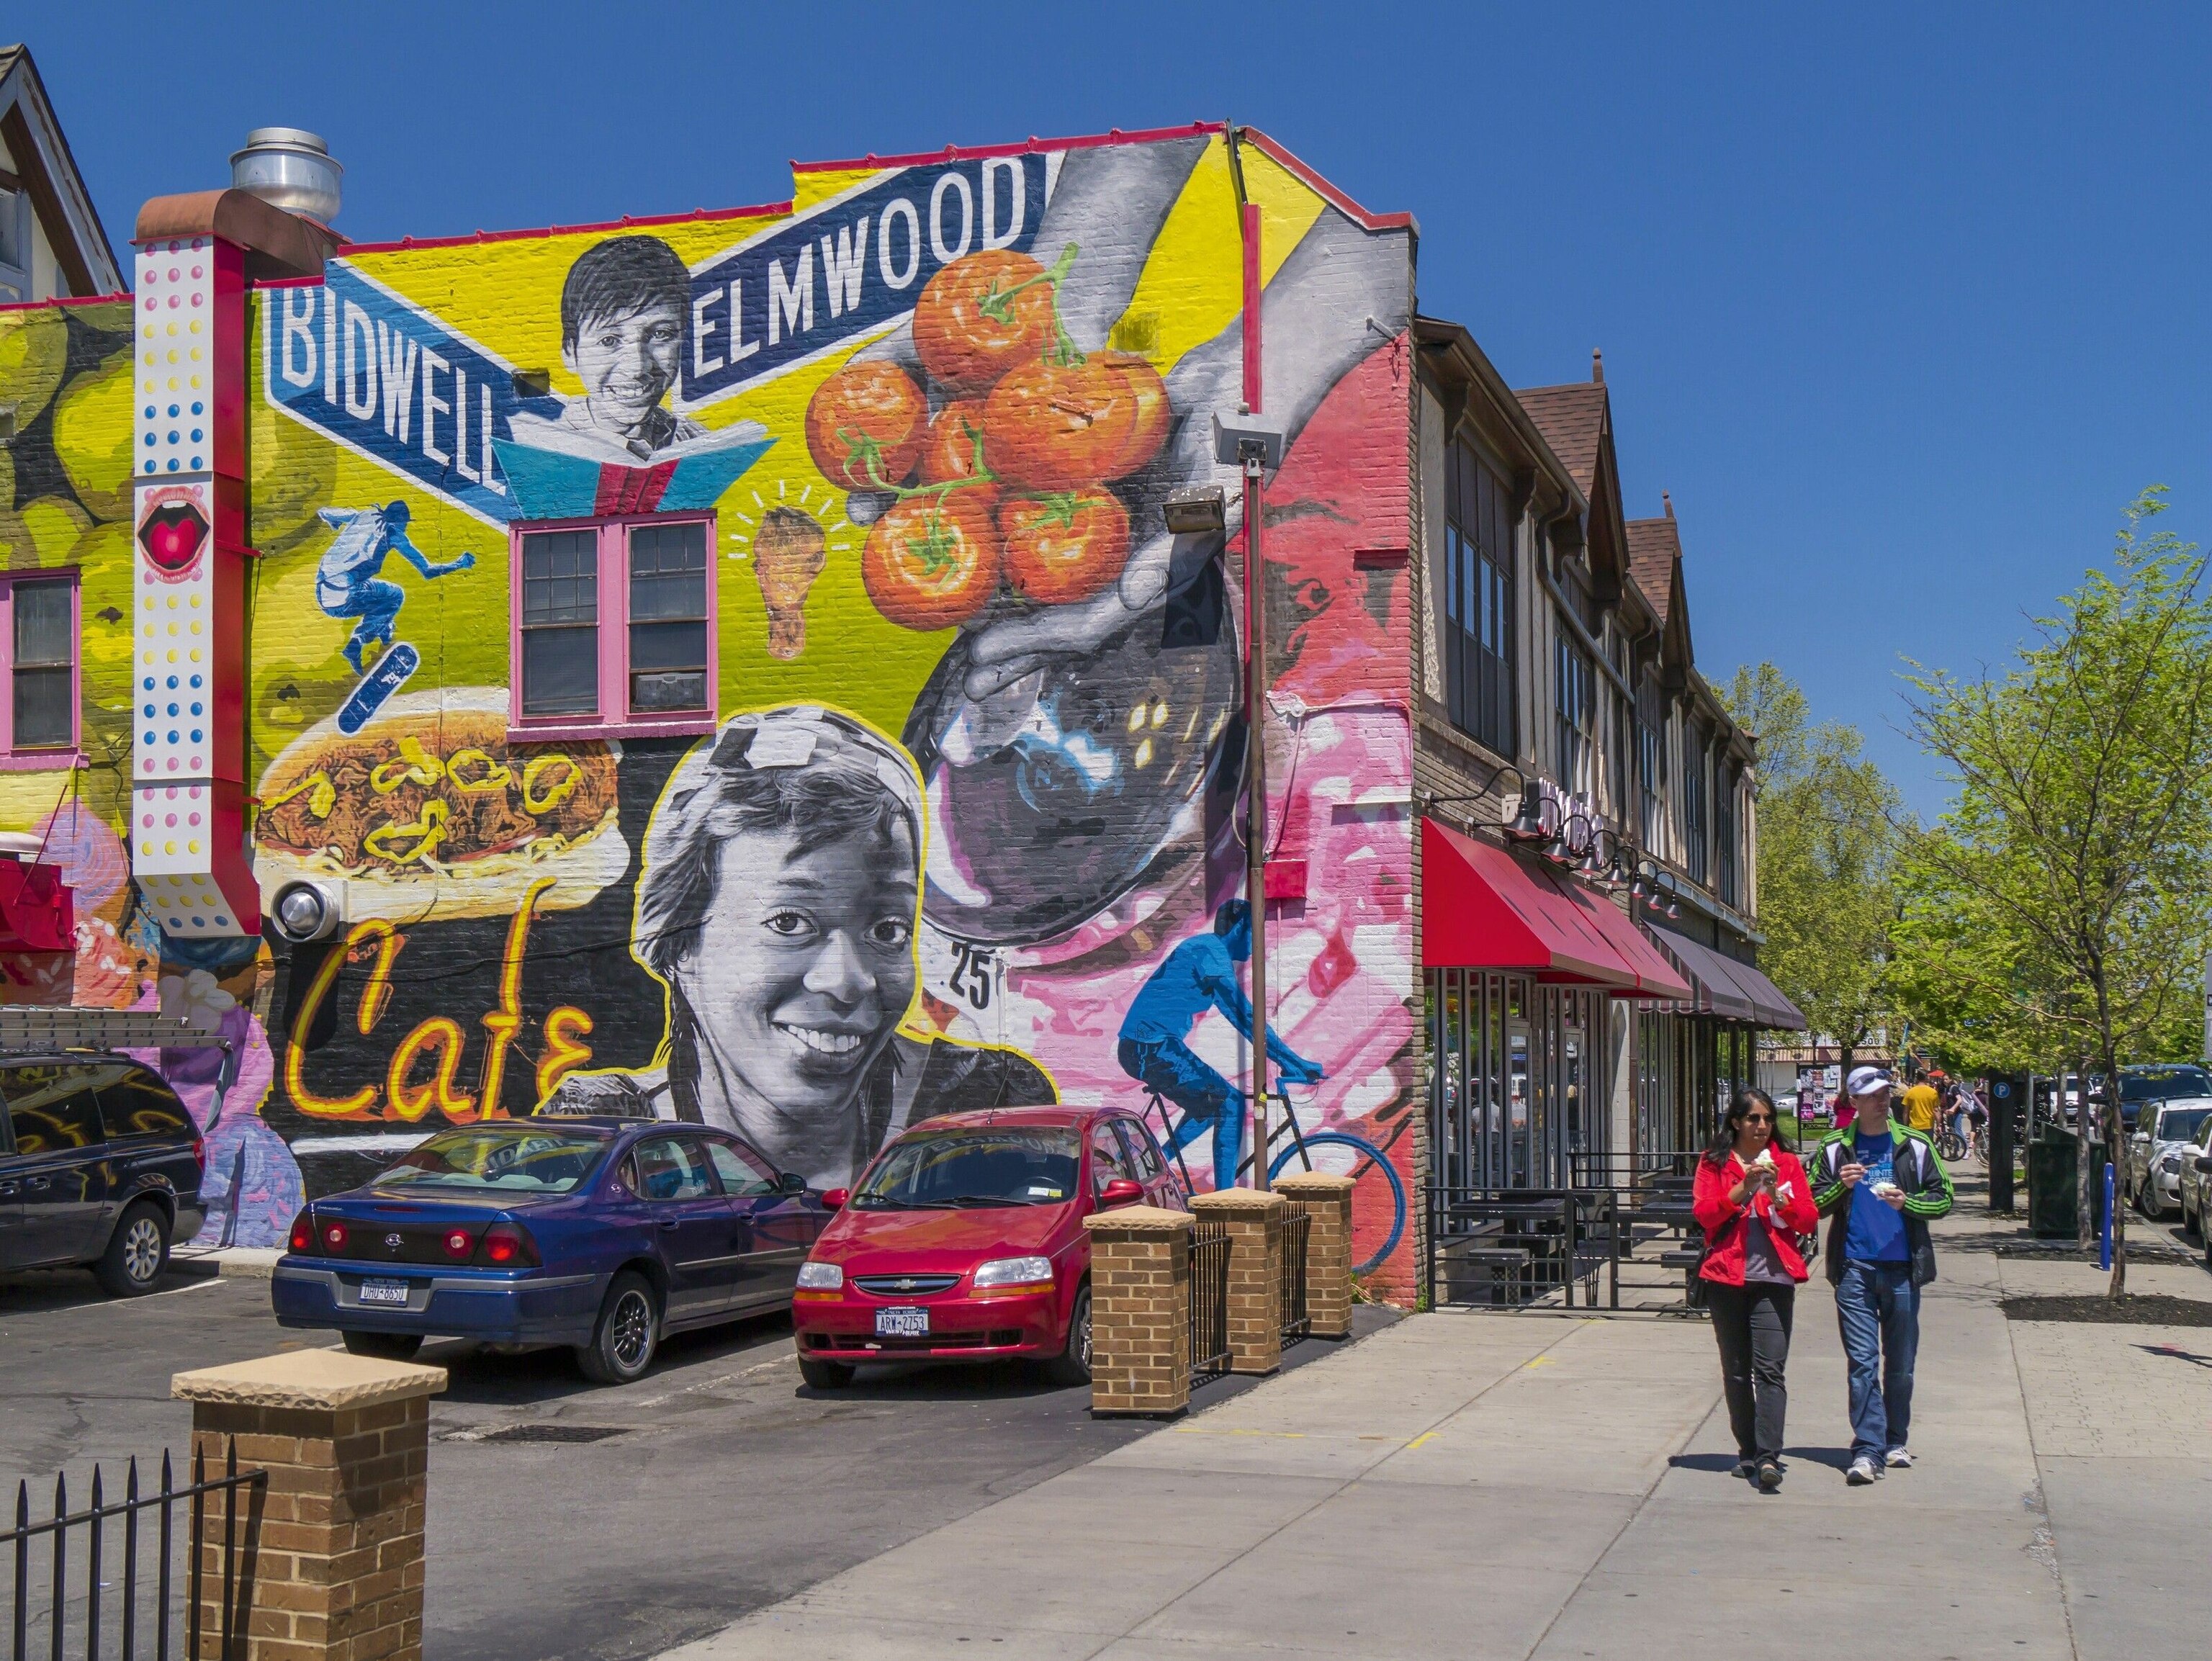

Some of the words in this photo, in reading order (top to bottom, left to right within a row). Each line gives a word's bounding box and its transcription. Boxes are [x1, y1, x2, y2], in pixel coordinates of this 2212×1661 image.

[692, 157, 1025, 379] ELMWOOD
[282, 286, 507, 497] BIDWELL
[949, 941, 990, 1010] 25
[285, 876, 593, 1121] Cafe
[1998, 1085, 2006, 1096] P
[1868, 1169, 1894, 1177] WINTE
[384, 1284, 404, 1300] 8650
[902, 1315, 925, 1331] 2753
